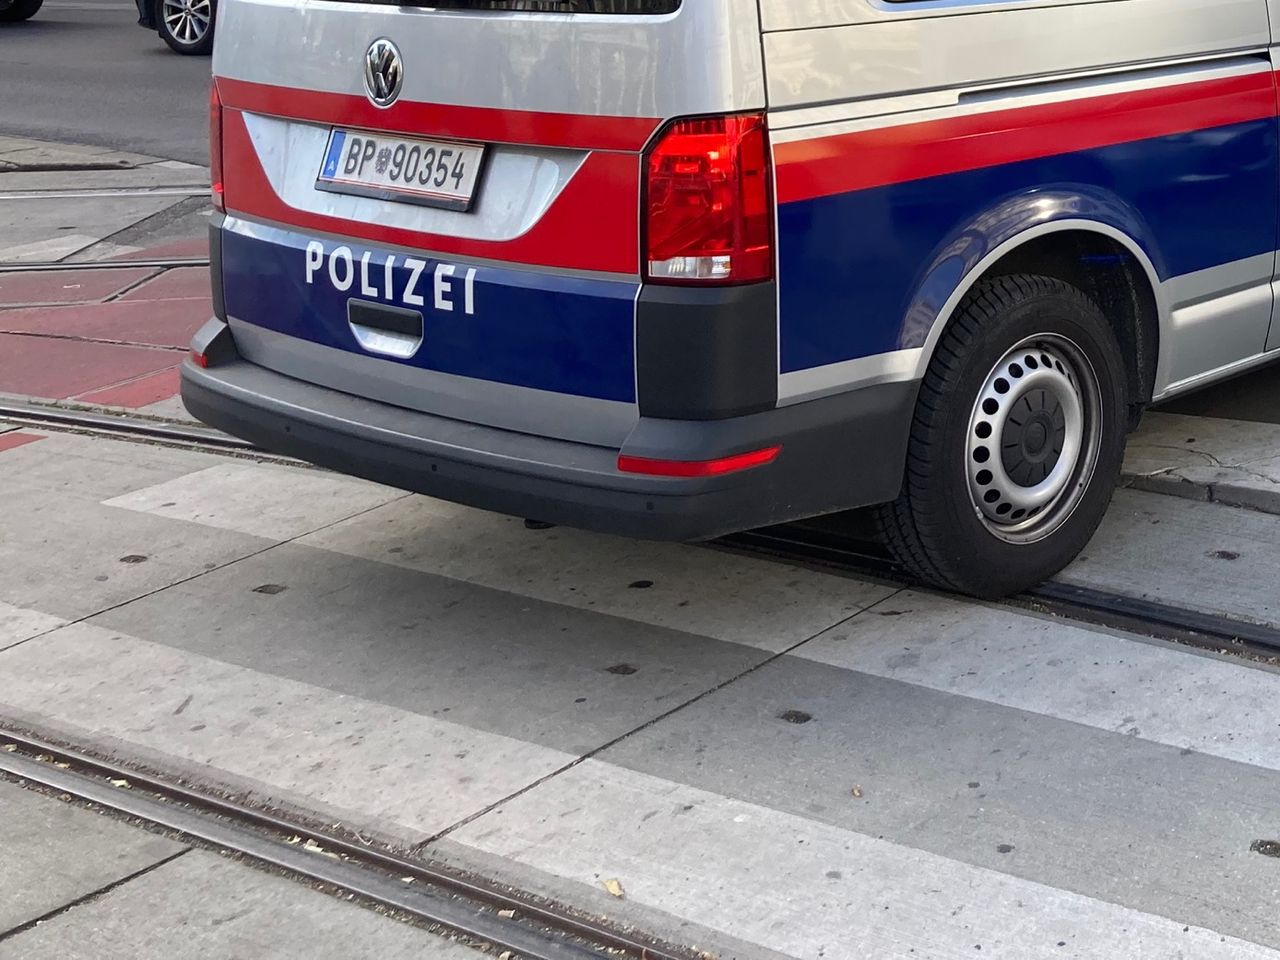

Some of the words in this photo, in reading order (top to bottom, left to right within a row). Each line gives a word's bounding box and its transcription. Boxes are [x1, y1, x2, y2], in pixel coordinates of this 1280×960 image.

[344, 137, 376, 178] BP
[389, 143, 464, 190] 90354
[306, 240, 477, 315] POLIZEI
